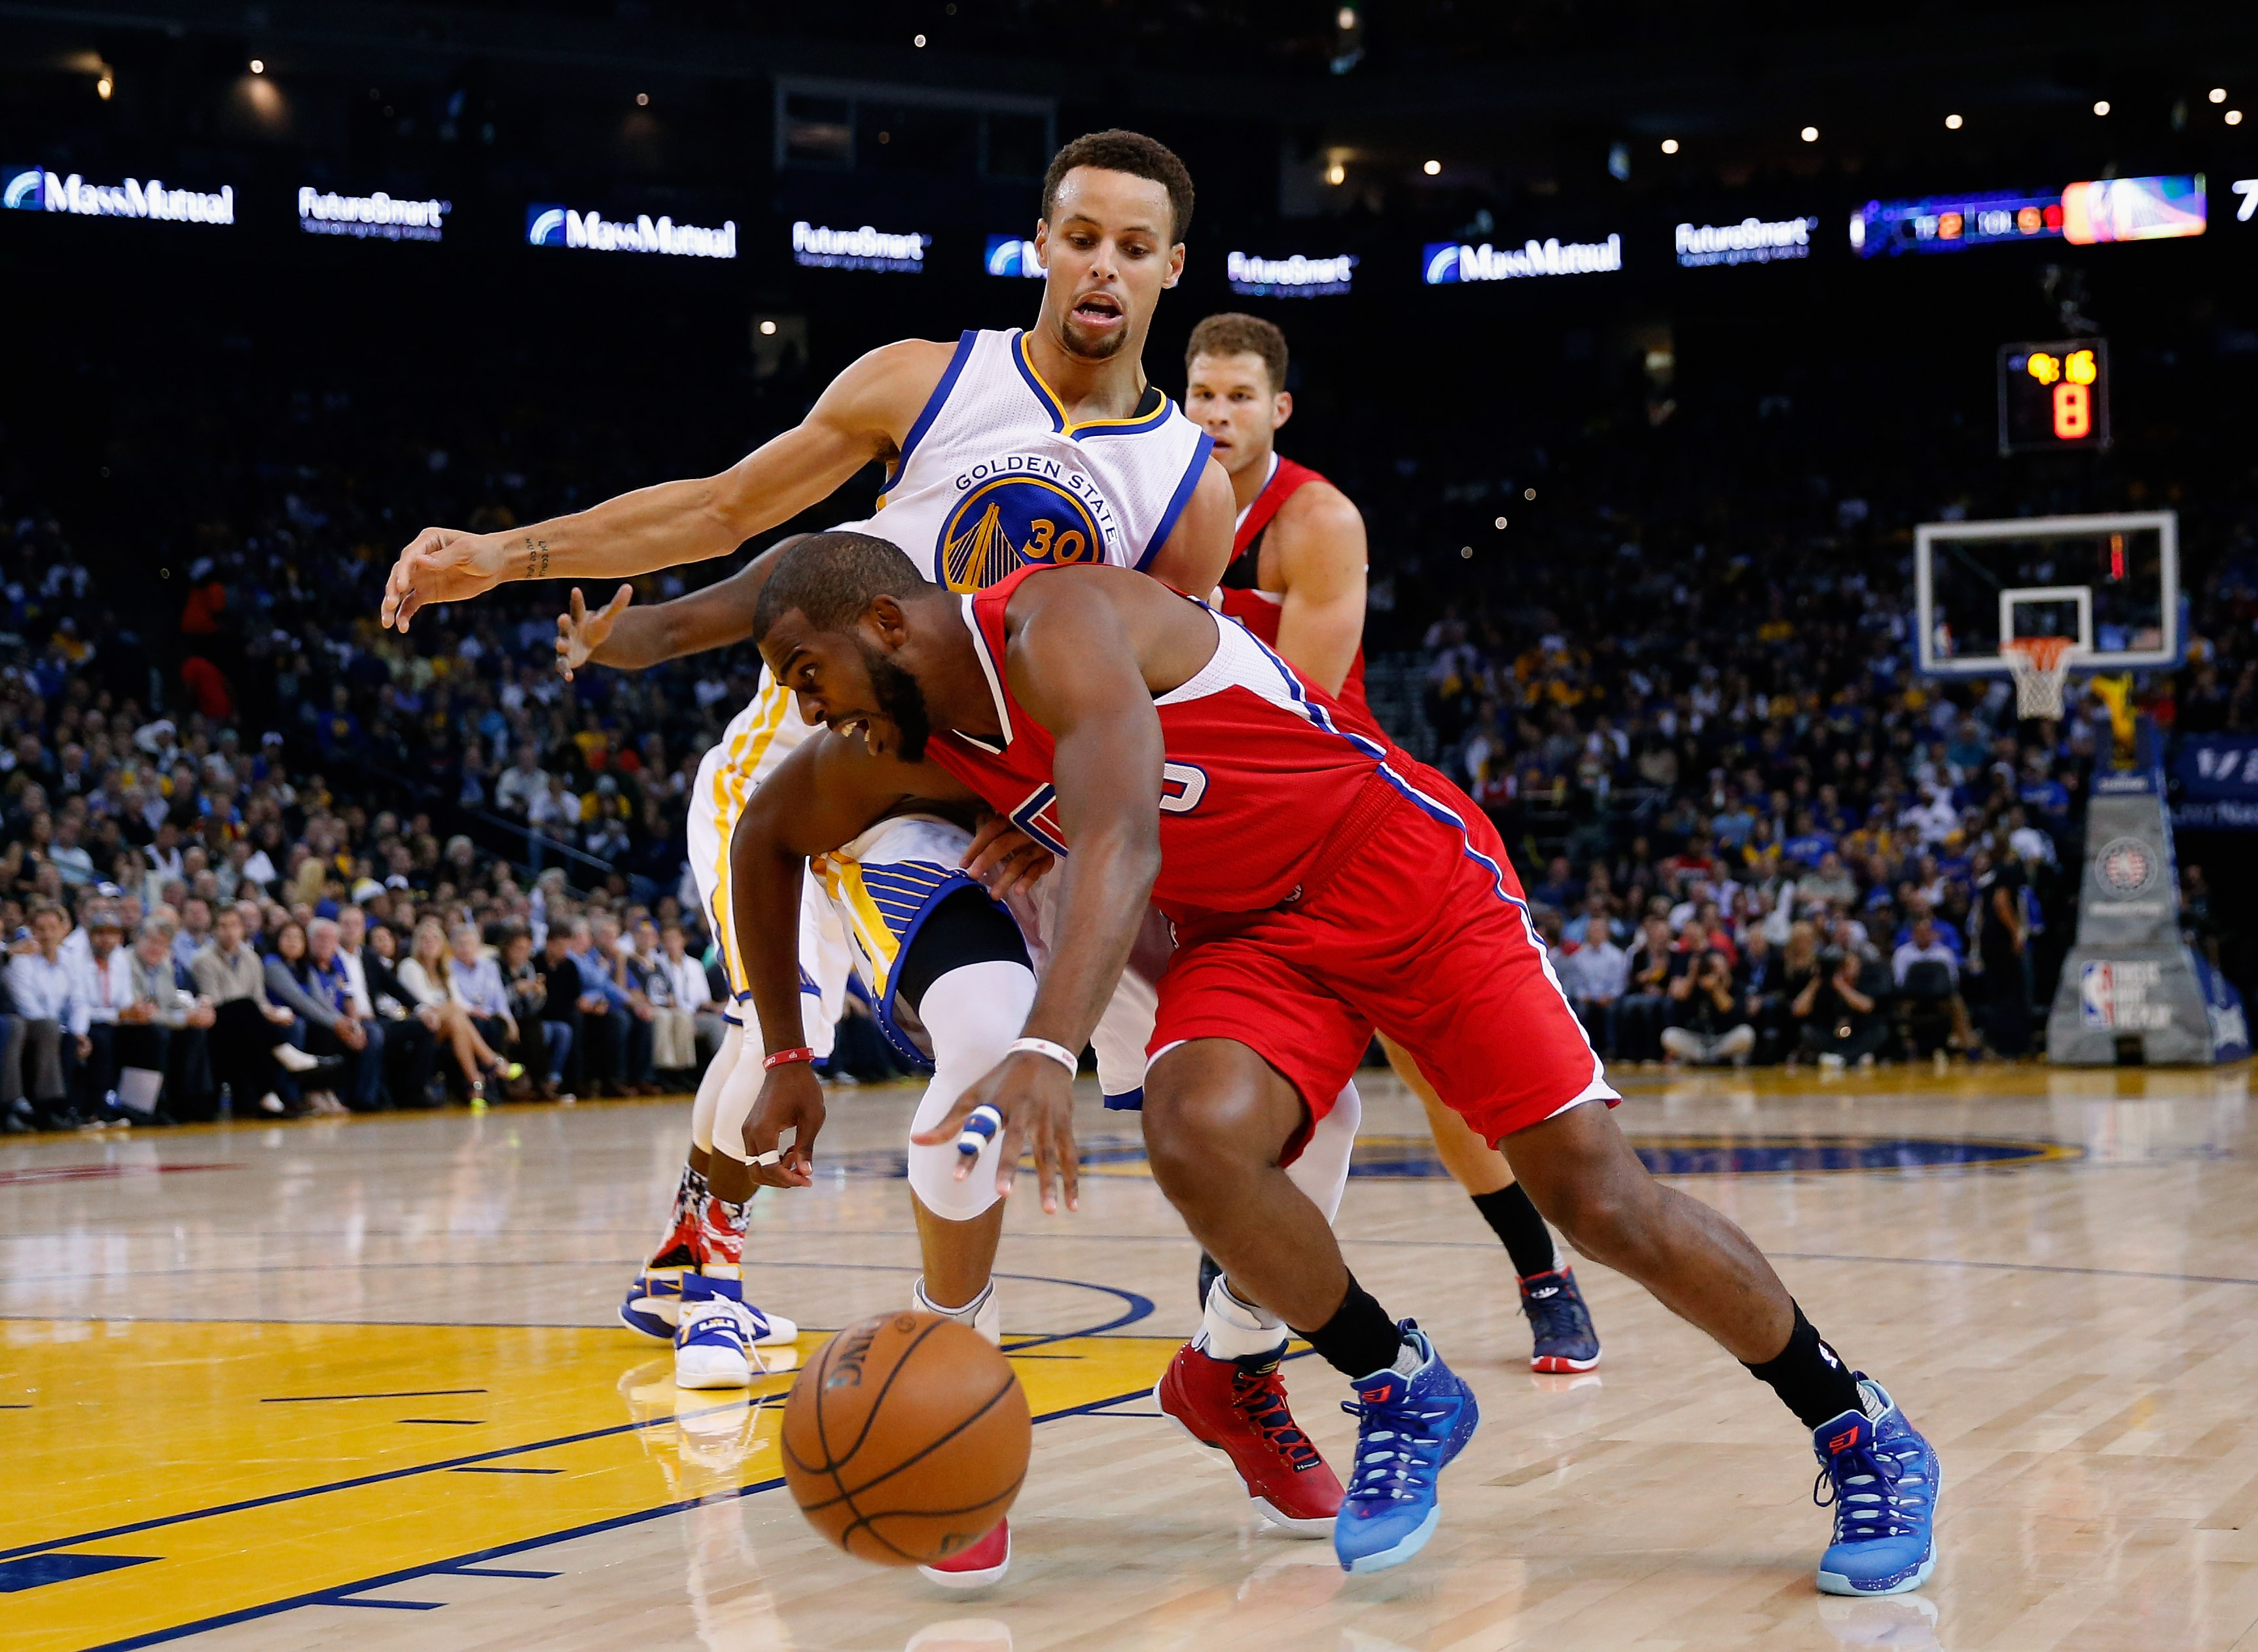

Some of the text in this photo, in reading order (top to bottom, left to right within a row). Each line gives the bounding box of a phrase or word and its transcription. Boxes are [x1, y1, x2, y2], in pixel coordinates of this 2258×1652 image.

[45, 171, 234, 224] MassMutual
[299, 187, 439, 228] FutureSmart
[566, 209, 736, 259] MassMutual
[793, 221, 921, 259] FutureSmart
[1460, 233, 1621, 282] MassMutual
[1676, 218, 1806, 253] FutureSmart
[1228, 251, 1349, 285] FutureSmart
[2053, 383, 2090, 439] 8
[956, 456, 1119, 543] GOLDEN STATE
[1022, 519, 1085, 564] 30
